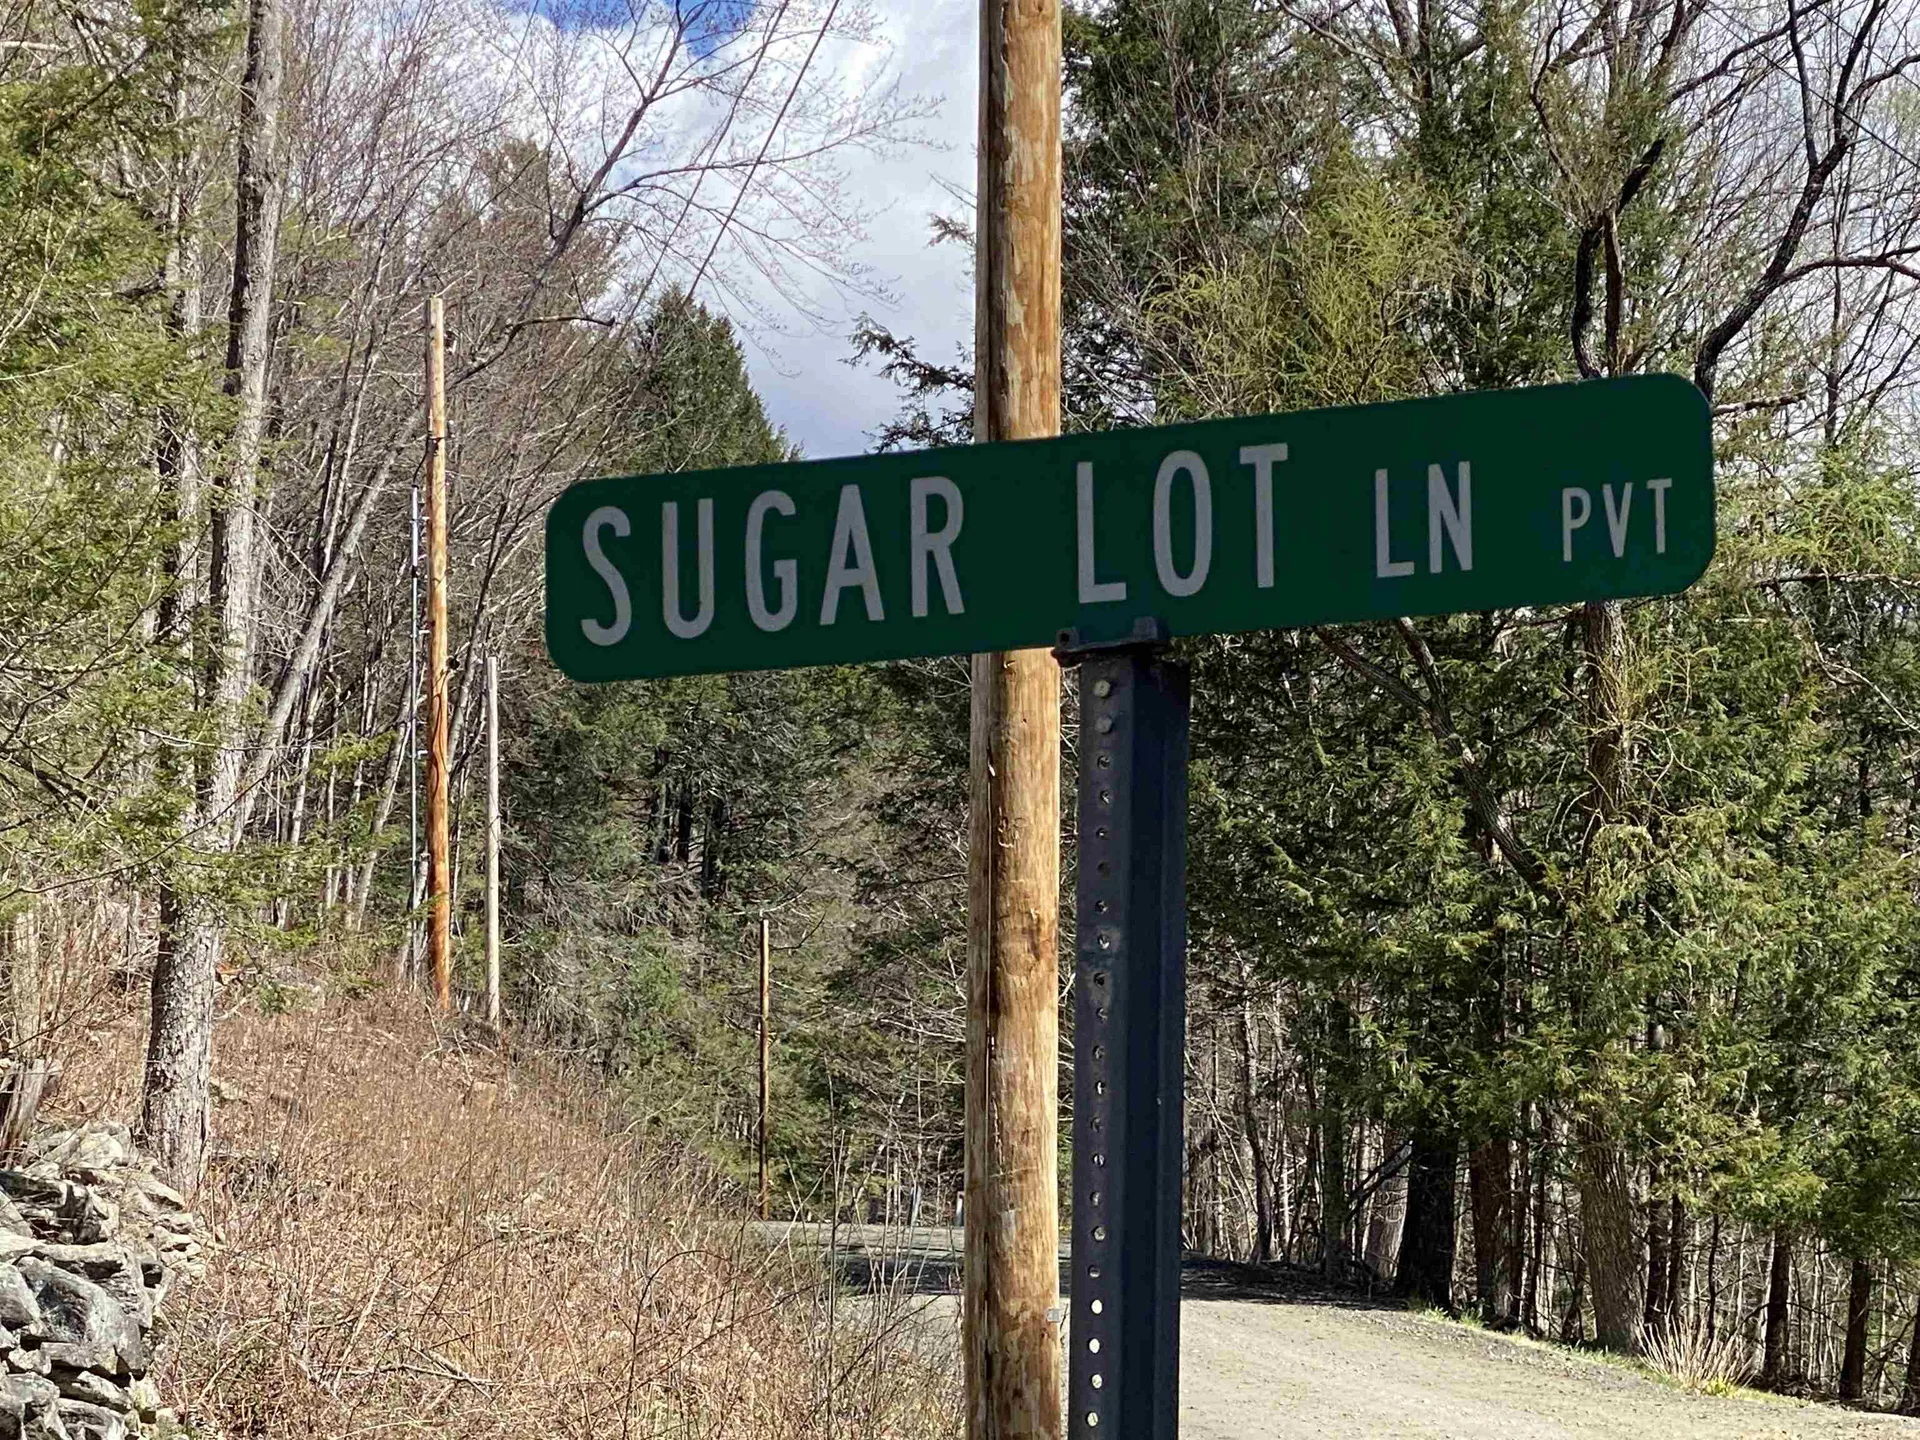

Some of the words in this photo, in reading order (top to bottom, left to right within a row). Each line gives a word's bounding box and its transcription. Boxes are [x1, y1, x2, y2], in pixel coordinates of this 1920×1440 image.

[581, 475, 965, 646] SUGAR
[1076, 442, 1289, 604] LOT
[1375, 461, 1473, 578] LN
[1561, 478, 1673, 563] PVT
